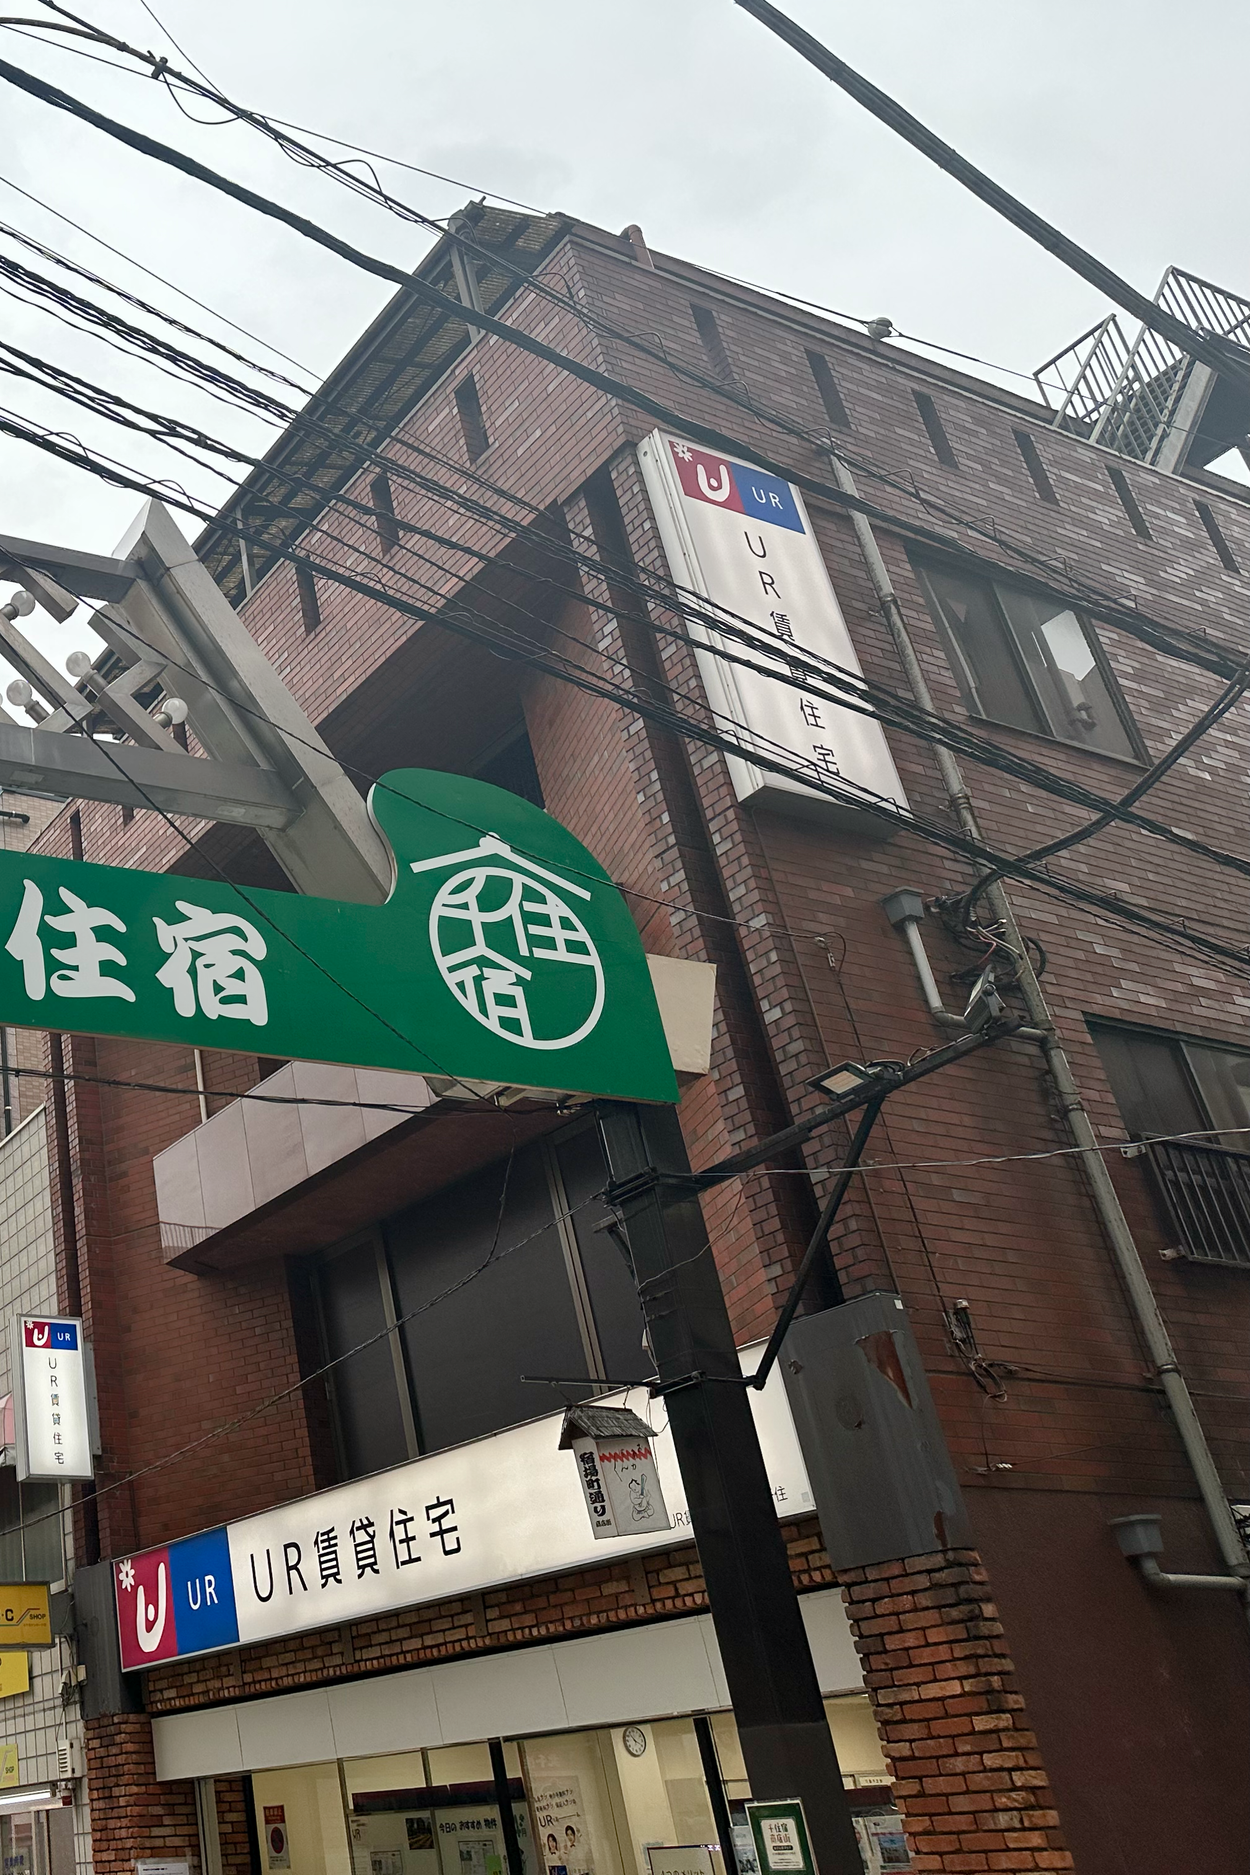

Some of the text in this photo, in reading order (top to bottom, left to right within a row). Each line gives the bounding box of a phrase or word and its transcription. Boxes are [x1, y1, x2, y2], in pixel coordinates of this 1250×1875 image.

[751, 485, 784, 511] UR
[57, 1331, 71, 1342] UR
[48, 1356, 65, 1465] UR賃貸住宅
[579, 1451, 607, 1518] 宿場町通り
[770, 1485, 789, 1504] 住
[187, 1574, 219, 1611] UR
[250, 1495, 463, 1604] UR賃貸住宅
